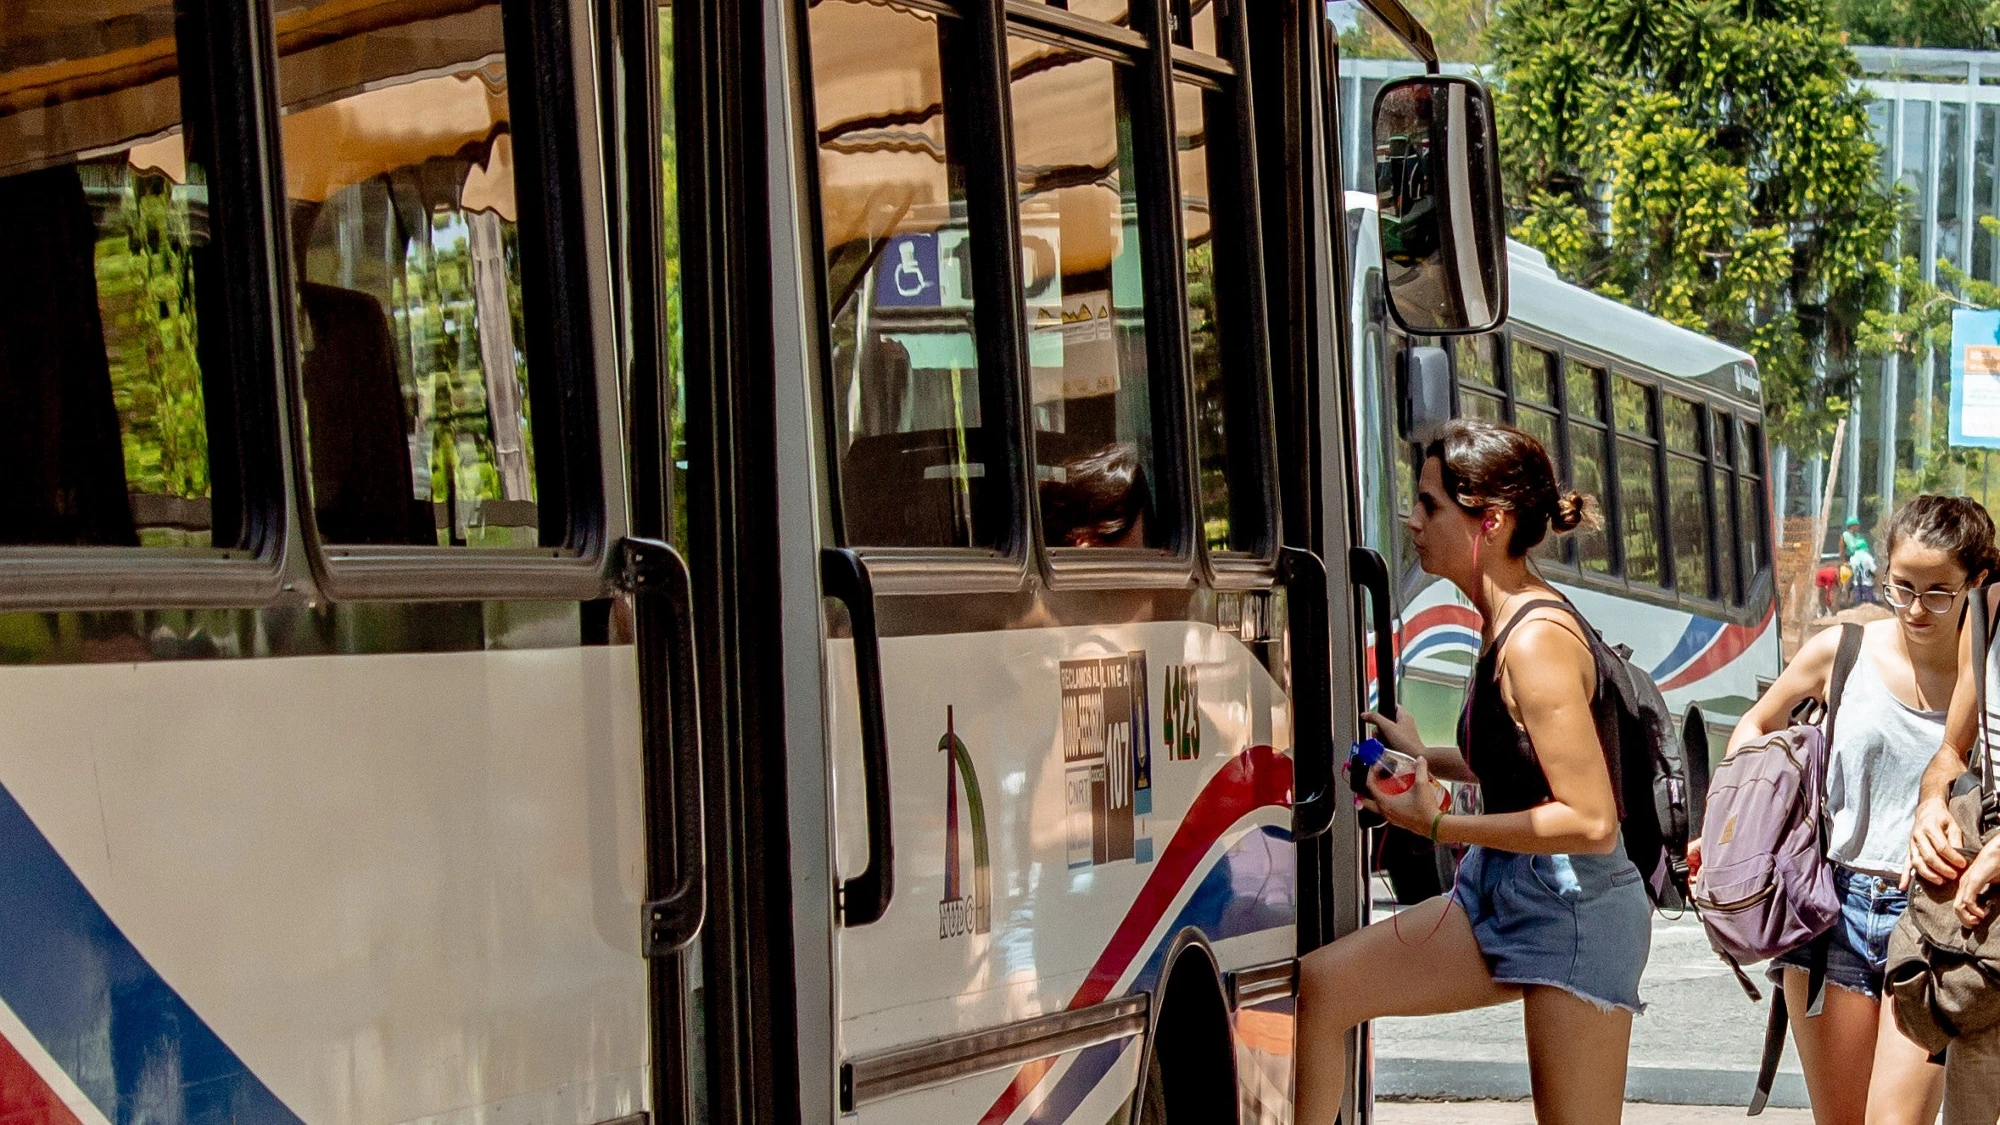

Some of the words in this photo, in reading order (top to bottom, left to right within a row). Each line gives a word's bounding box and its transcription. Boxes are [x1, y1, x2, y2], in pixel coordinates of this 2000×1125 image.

[1163, 665, 1200, 761] 4123
[1067, 779, 1089, 806] CNRT
[1105, 721, 1129, 810] 107
[939, 895, 975, 940] NUDO
